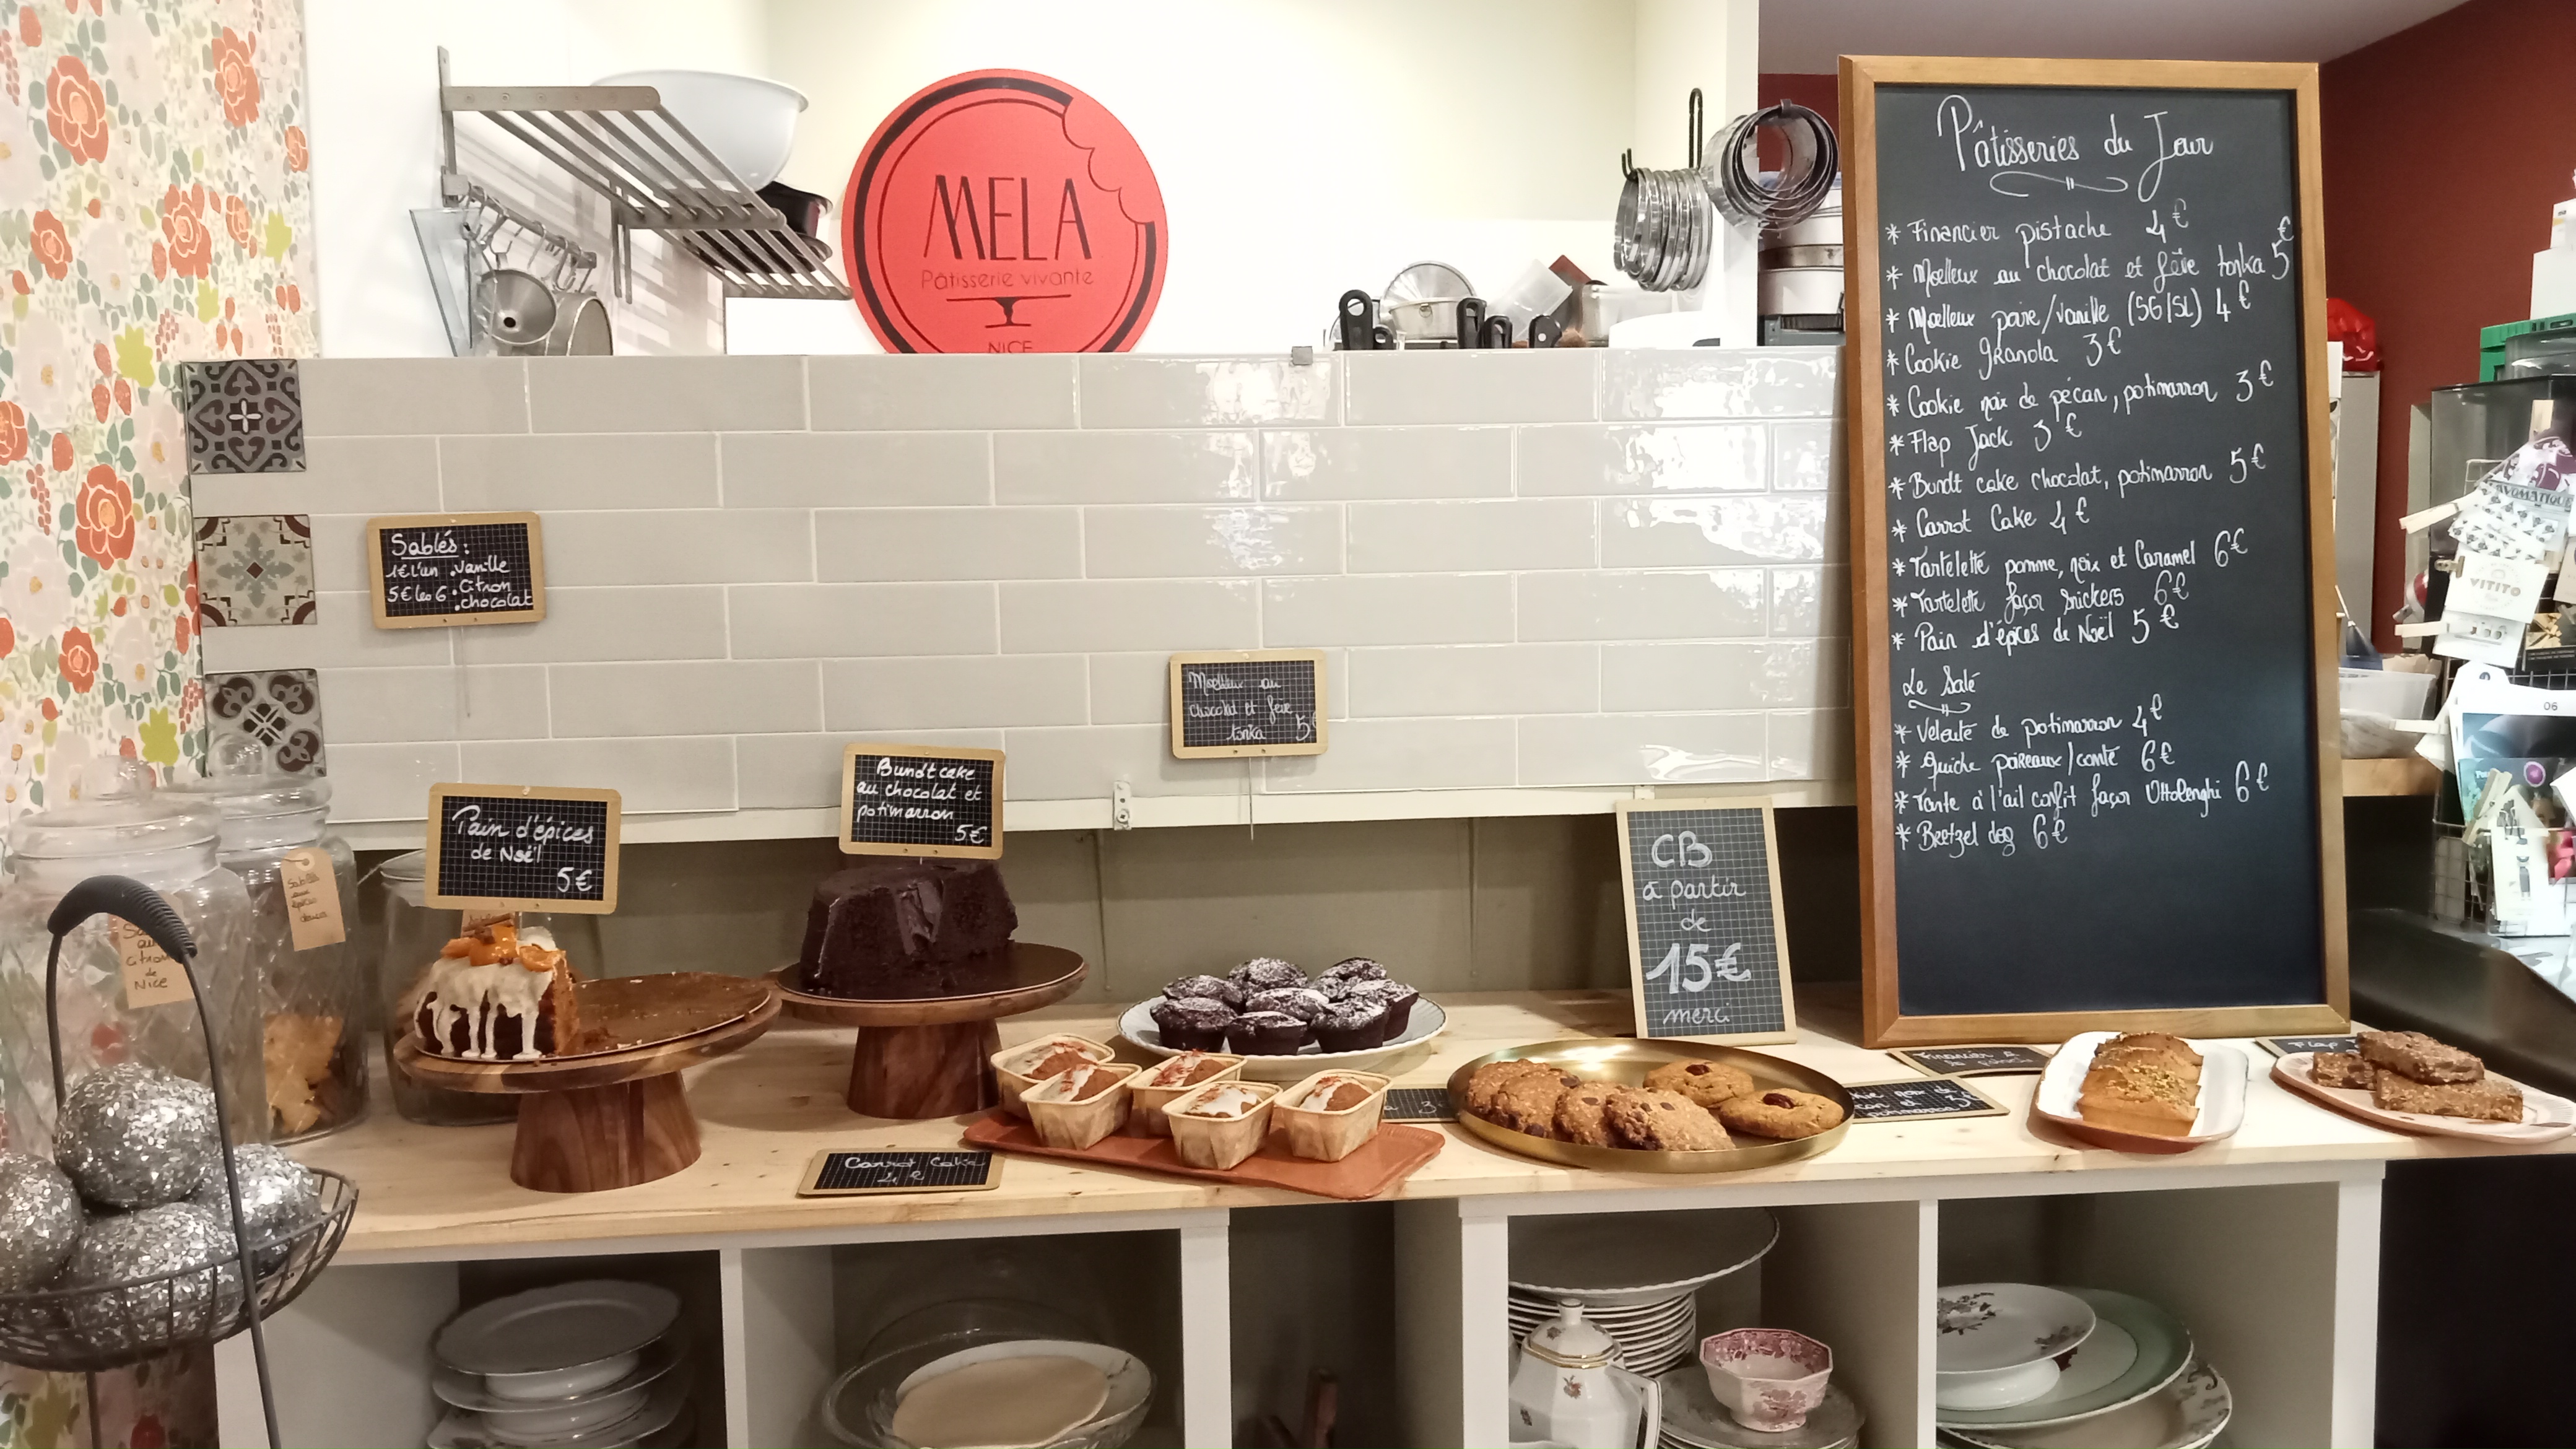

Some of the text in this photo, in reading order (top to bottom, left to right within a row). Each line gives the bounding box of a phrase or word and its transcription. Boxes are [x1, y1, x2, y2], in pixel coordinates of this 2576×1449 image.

[1937, 95, 2214, 202] Pâtisseries du Jour
[923, 175, 1092, 261] MELA
[1907, 219, 2000, 242] Financier
[2015, 211, 2112, 269] pistache
[921, 268, 1094, 290] Pâtisserie vivante
[1993, 269, 2021, 285] au
[2037, 253, 2111, 282] chocolat
[2125, 255, 2143, 279] et
[2217, 242, 2266, 277] tonka
[988, 340, 1033, 353] NICE
[1905, 342, 1962, 375] Cookie
[1908, 385, 1964, 419] Cookie
[2019, 381, 2039, 409] de
[1907, 429, 1951, 468] Flap
[1964, 424, 2013, 471] Jack
[1908, 470, 1964, 499] Bundt
[1975, 468, 2019, 494] cake
[2117, 459, 2213, 498] potimarron
[1916, 507, 1972, 539] Carrot
[1990, 503, 2037, 532] Cake
[1909, 546, 1990, 578] Tartelette
[2110, 546, 2128, 570] et
[2135, 539, 2196, 570] Caramel
[435, 586, 447, 602] 6
[1910, 588, 1985, 613] Tartelette
[2470, 578, 2521, 596] VITITO
[1914, 622, 1957, 651] Pain
[1972, 619, 2040, 656] d'épices
[2053, 617, 2071, 642] de
[2078, 611, 2115, 644] Noël
[1259, 678, 1281, 689] au
[1902, 664, 1981, 697] Le Salé
[2544, 702, 2557, 711] 06
[1917, 716, 1978, 743] Velouté
[1991, 715, 2009, 739] de
[2021, 712, 2123, 749] potimarron
[877, 757, 975, 781] Bundt cake
[856, 780, 983, 801] au chocolat et
[1912, 788, 1960, 813] Tarte
[1972, 789, 1984, 811] à
[1990, 784, 2025, 811] l'ail
[2091, 773, 2131, 817] façon
[2145, 777, 2222, 818] Ottolenghi
[452, 805, 594, 845] Pain d'épices
[856, 802, 954, 822] potimarron
[955, 824, 988, 844] 5€
[1651, 830, 1713, 868] CB
[1915, 820, 1980, 859] Bretzel
[1988, 820, 2016, 857] dog
[471, 842, 542, 863] de Noël
[557, 867, 593, 892] 5€
[1642, 874, 1746, 910] à partir
[1681, 908, 1712, 933] de
[1645, 942, 1752, 994] 15€
[1663, 1002, 1730, 1025] merci
